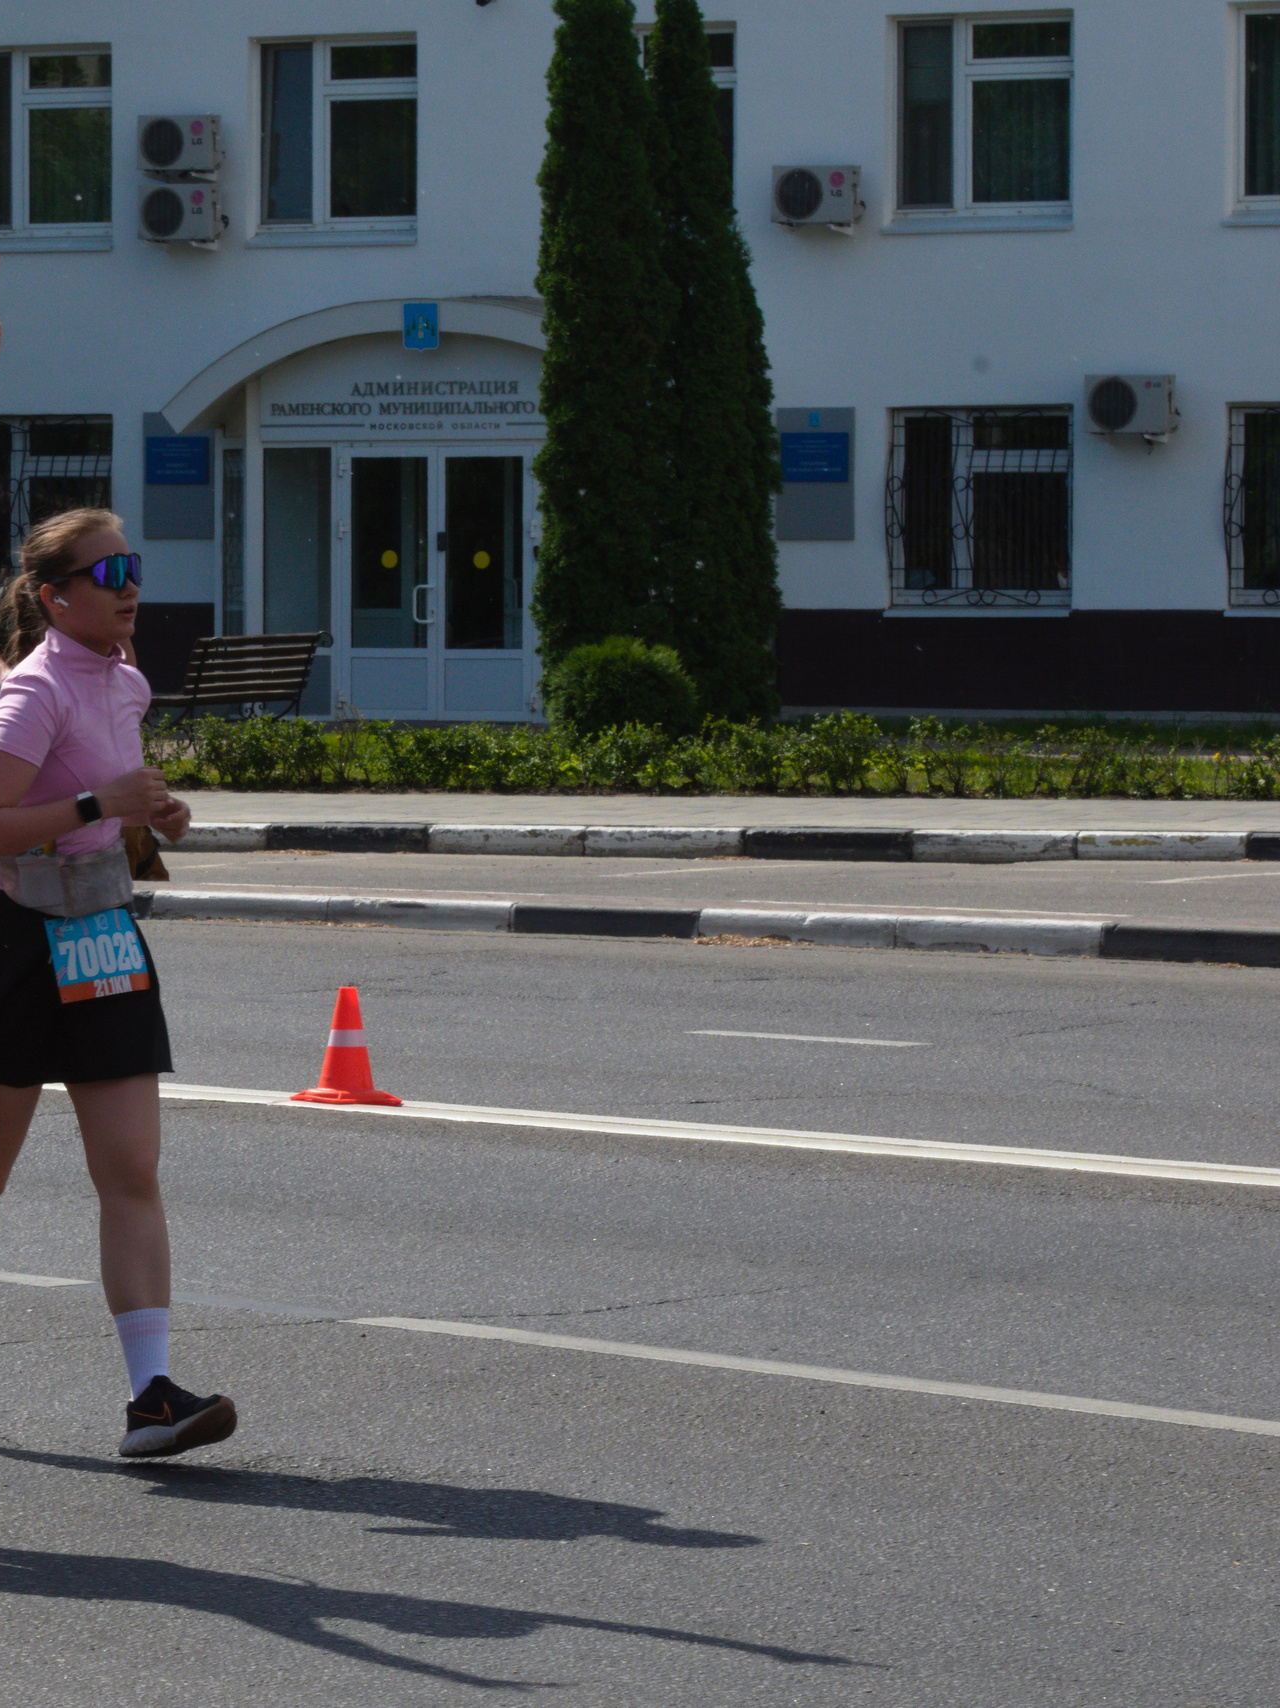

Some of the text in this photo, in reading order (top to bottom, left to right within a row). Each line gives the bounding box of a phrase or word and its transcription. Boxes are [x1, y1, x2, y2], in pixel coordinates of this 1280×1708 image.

[351, 381, 519, 398] АДМИНИСТРАЦИЯ
[271, 401, 536, 416] РАМЕНСКОГО МУНИЦИПАЛЬНОГО
[370, 421, 501, 431] МОСКОВСКОЙ ОБЛАСТИ
[57, 931, 143, 981] 70026
